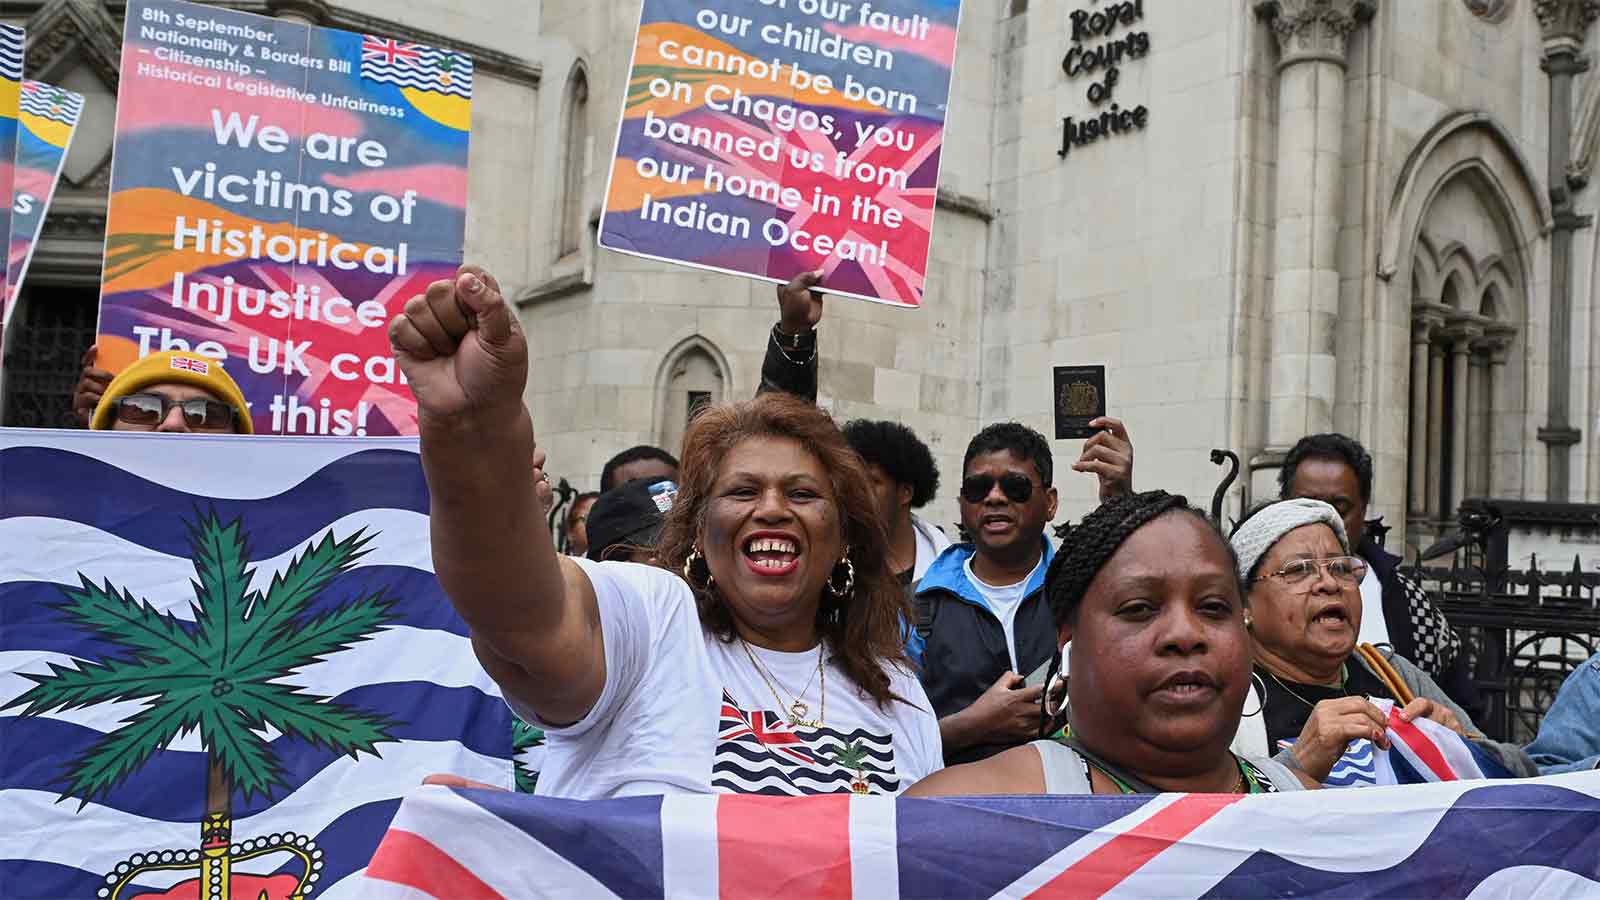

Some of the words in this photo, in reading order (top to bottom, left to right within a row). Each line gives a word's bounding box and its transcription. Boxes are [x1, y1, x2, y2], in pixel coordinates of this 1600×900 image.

[142, 8, 170, 25] 8th
[696, 9, 752, 37] our
[761, 23, 894, 71] children
[800, 0, 850, 22] our
[860, 6, 930, 41] fault
[1070, 0, 1144, 41] Royal
[141, 25, 238, 56] Nationality
[243, 45, 256, 58] &
[261, 47, 323, 70] Borders
[329, 59, 352, 74] Bill
[154, 47, 251, 76] Citizenship
[659, 39, 780, 82] cannot
[791, 62, 833, 95] be
[844, 74, 917, 114] born
[1062, 32, 1149, 77] Courts
[137, 63, 221, 89] Historical
[226, 77, 316, 104] Legislative
[321, 93, 405, 118] Unfairness
[649, 76, 692, 104] on
[704, 84, 842, 140] Chagos,
[855, 121, 915, 151] you
[1087, 67, 1119, 104] of
[211, 109, 290, 153] We
[305, 131, 388, 168] are
[644, 111, 780, 162] banned
[790, 148, 823, 173] us
[835, 151, 908, 190] from
[1057, 102, 1148, 160] Justice
[172, 163, 353, 217] victims
[369, 191, 417, 225] of
[636, 156, 696, 185] our
[705, 166, 802, 208] home
[812, 187, 840, 217] in
[852, 196, 903, 229] the
[174, 215, 408, 276] Historical
[640, 194, 750, 239] Indian
[763, 218, 888, 267] Ocean!
[171, 272, 388, 328] Injustice
[248, 336, 312, 377] UK
[330, 352, 408, 385] ca
[270, 395, 368, 437] this!
